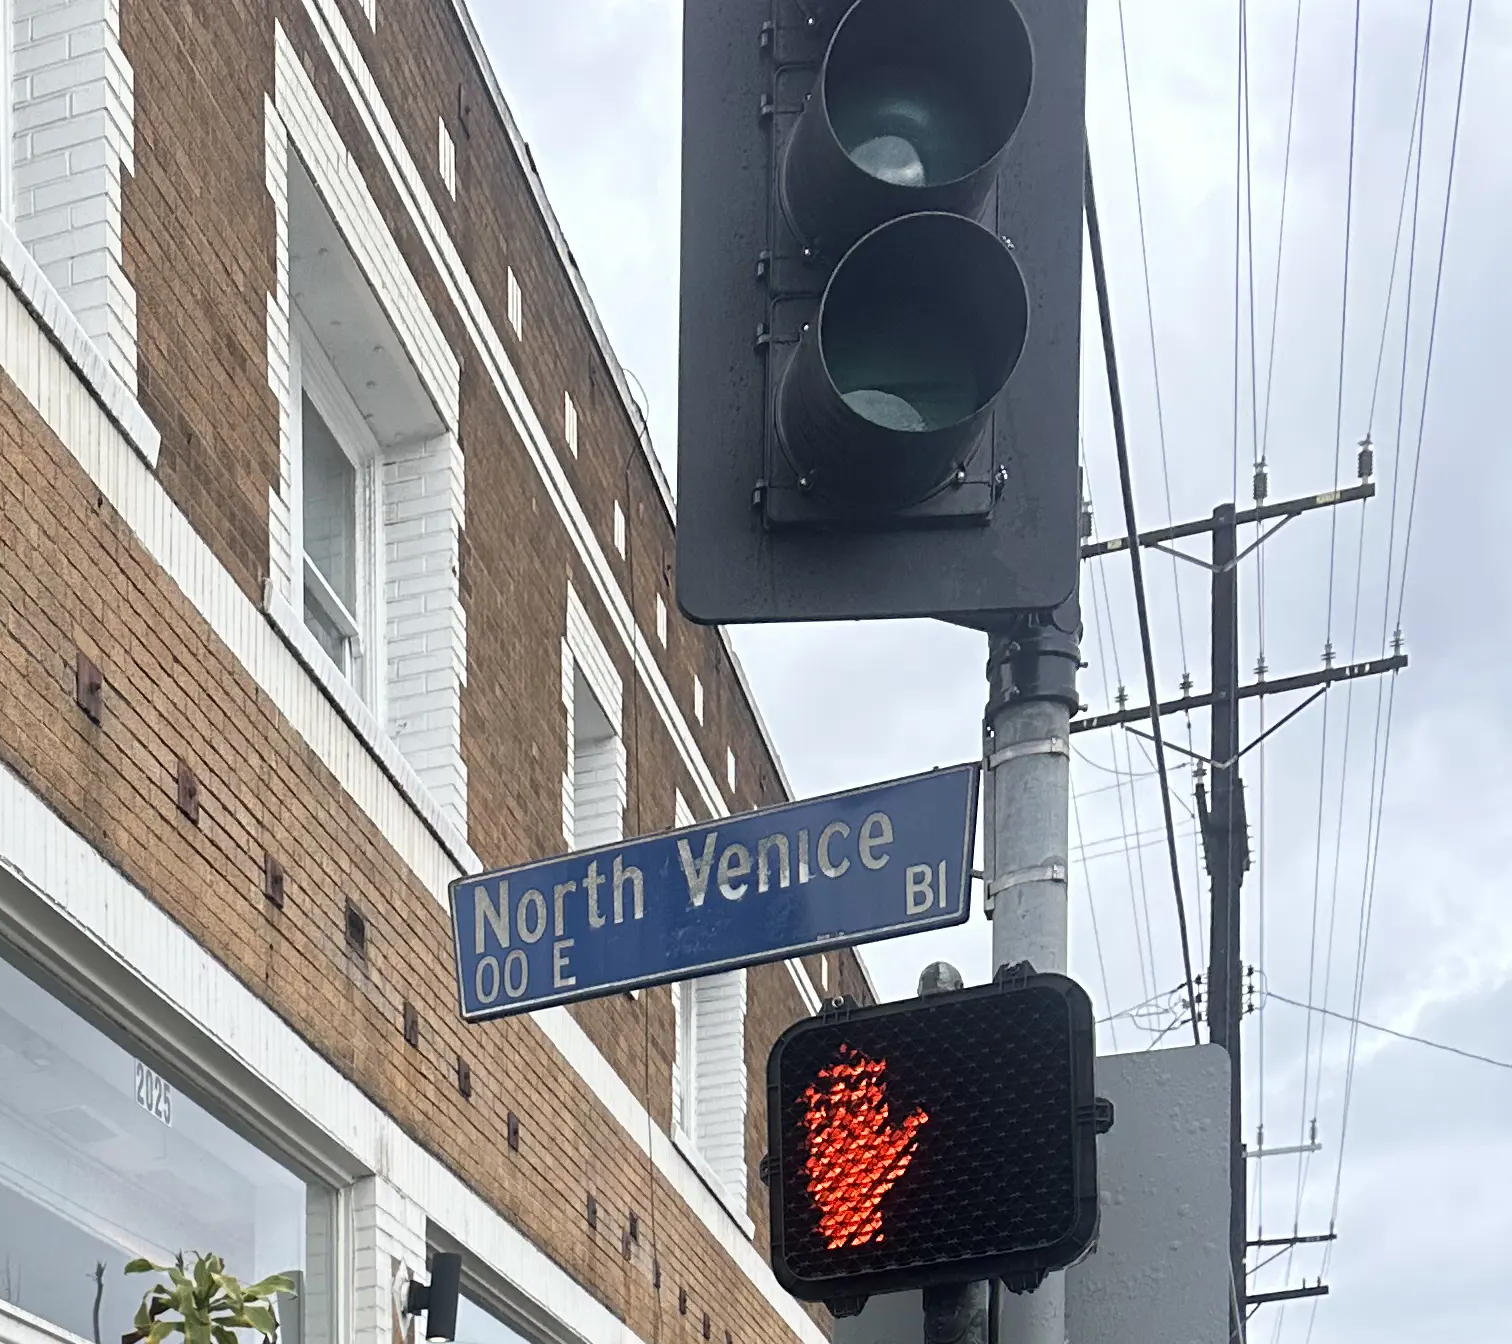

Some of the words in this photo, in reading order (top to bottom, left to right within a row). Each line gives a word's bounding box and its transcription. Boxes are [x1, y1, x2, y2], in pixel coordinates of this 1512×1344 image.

[473, 854, 645, 954] North
[676, 811, 894, 908] Venice
[905, 859, 948, 917] Bl
[475, 948, 529, 1004] 00
[553, 939, 577, 989] E
[136, 1062, 171, 1125] 2025
